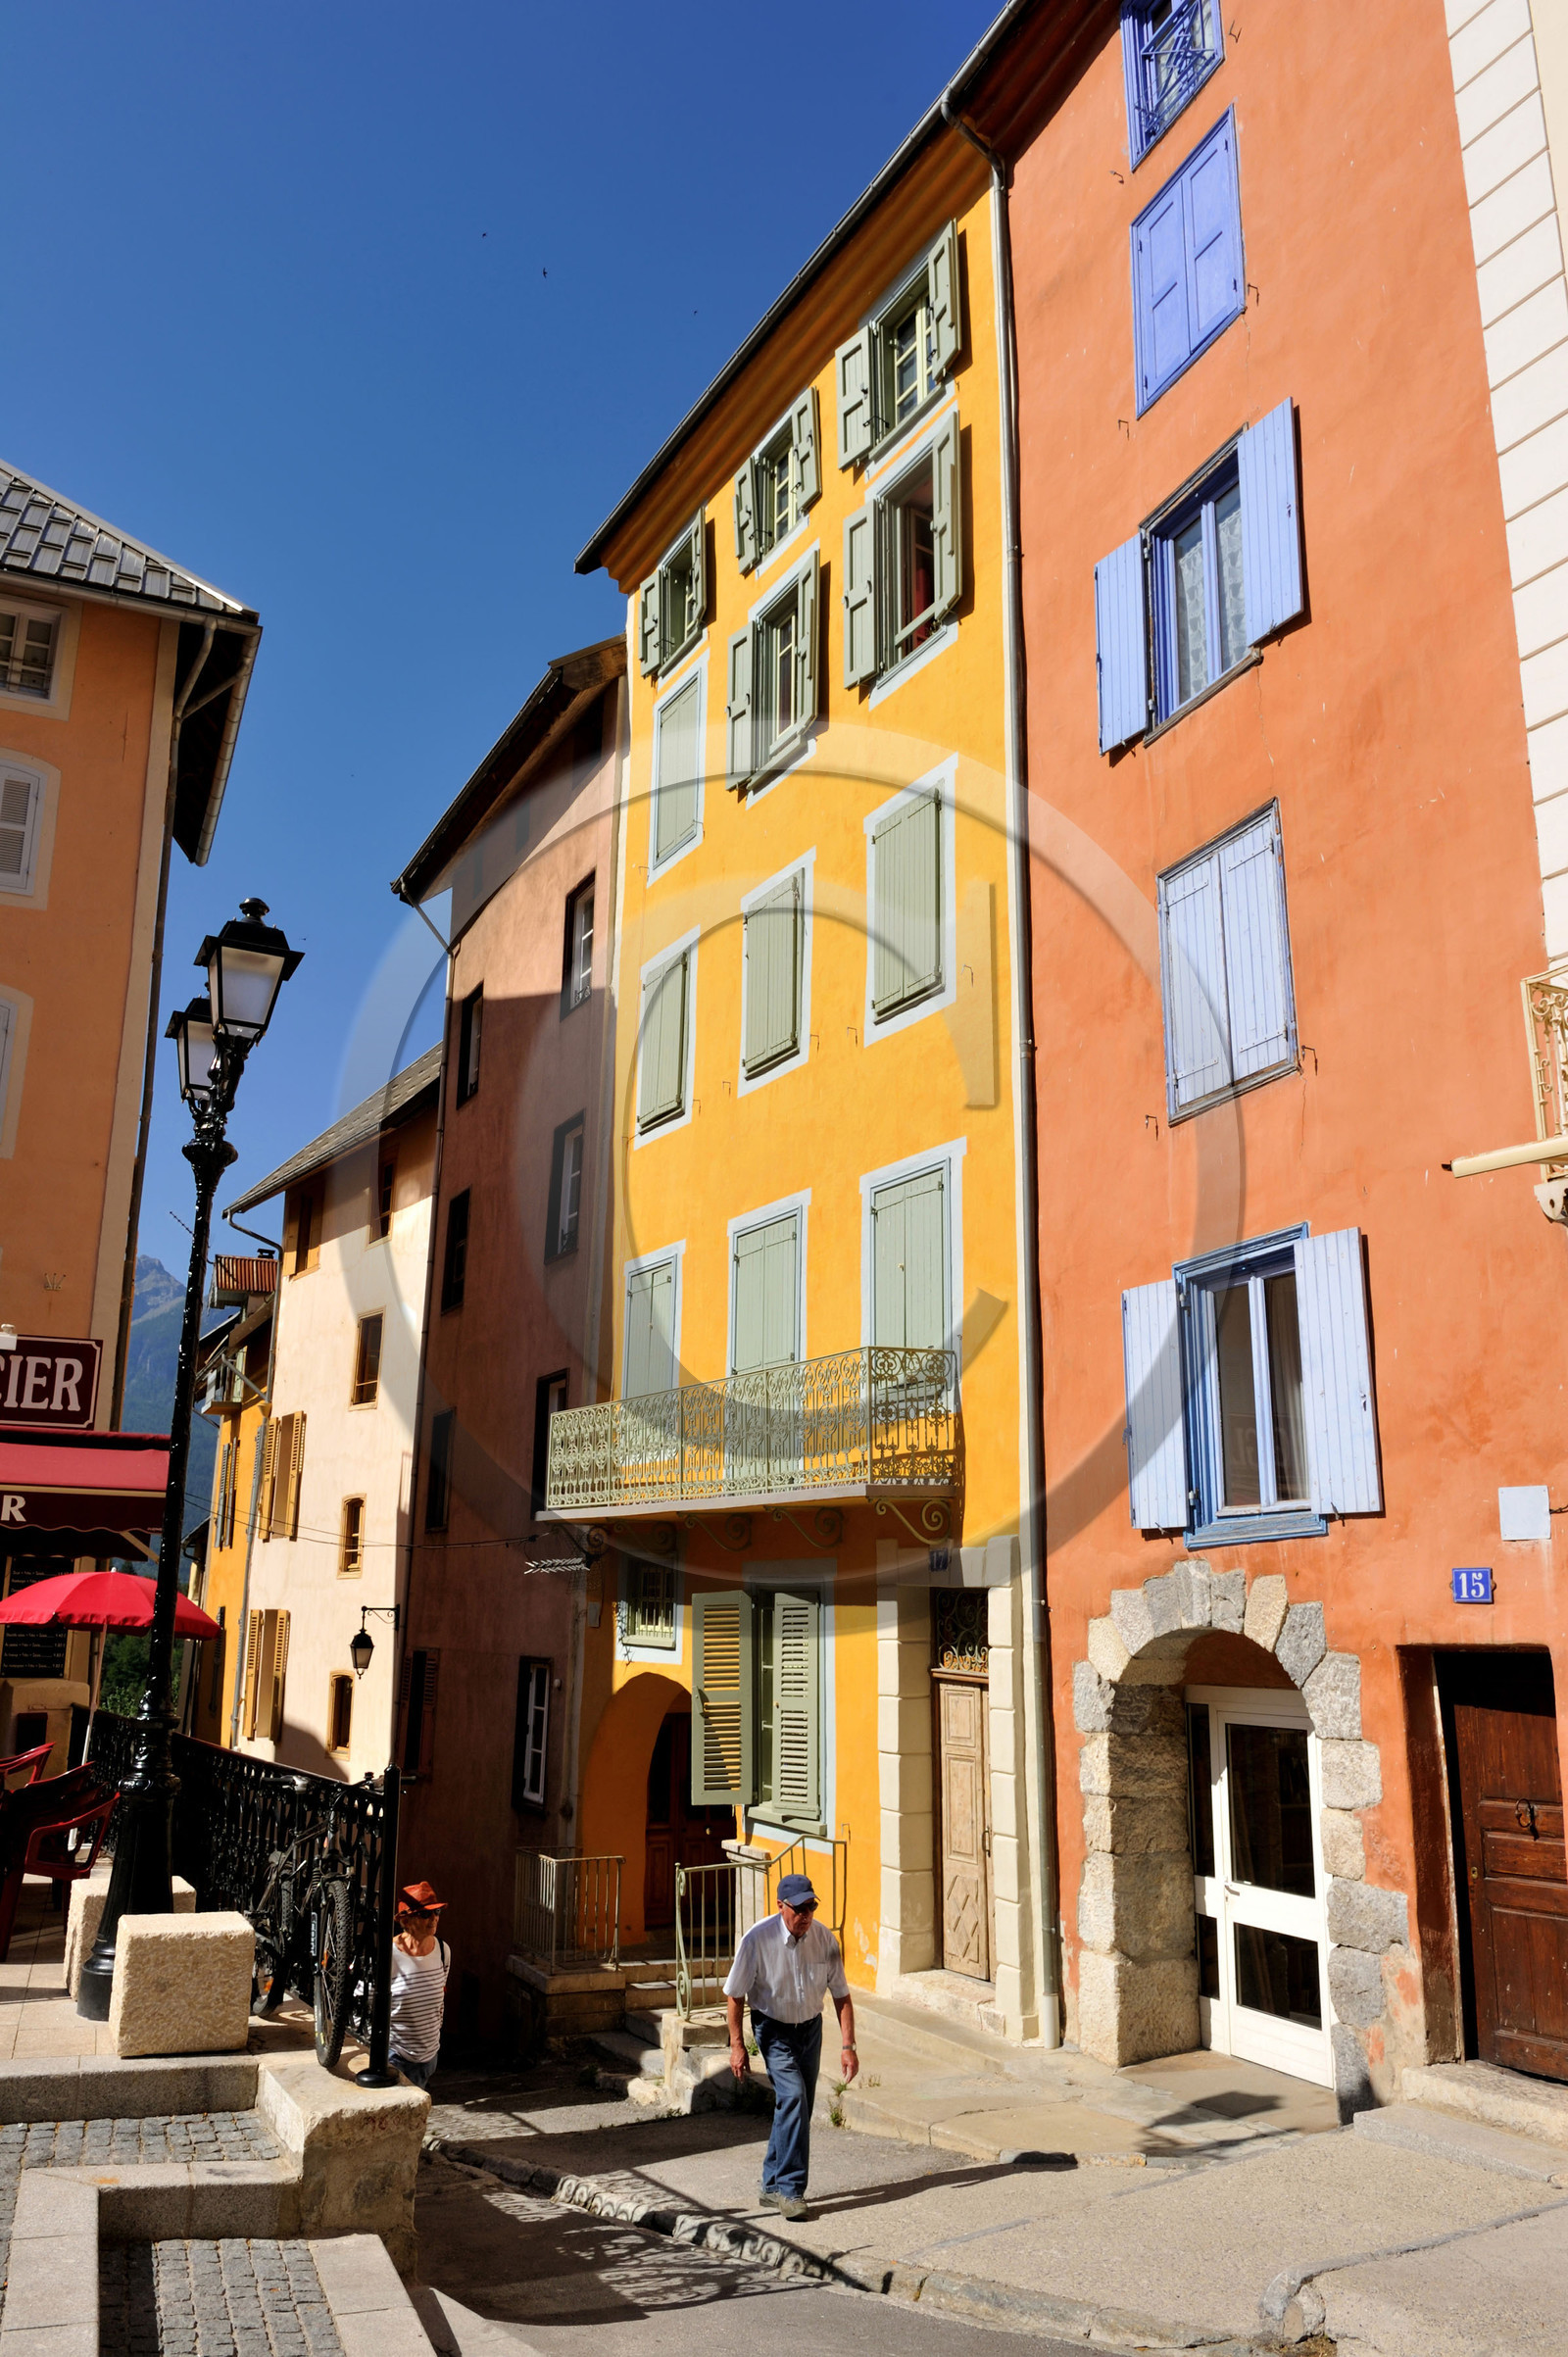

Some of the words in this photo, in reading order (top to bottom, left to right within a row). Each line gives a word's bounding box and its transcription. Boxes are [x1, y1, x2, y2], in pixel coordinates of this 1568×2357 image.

[0, 1354, 83, 1411] IER
[933, 1551, 946, 1568] 17
[1459, 1572, 1485, 1598] 15
